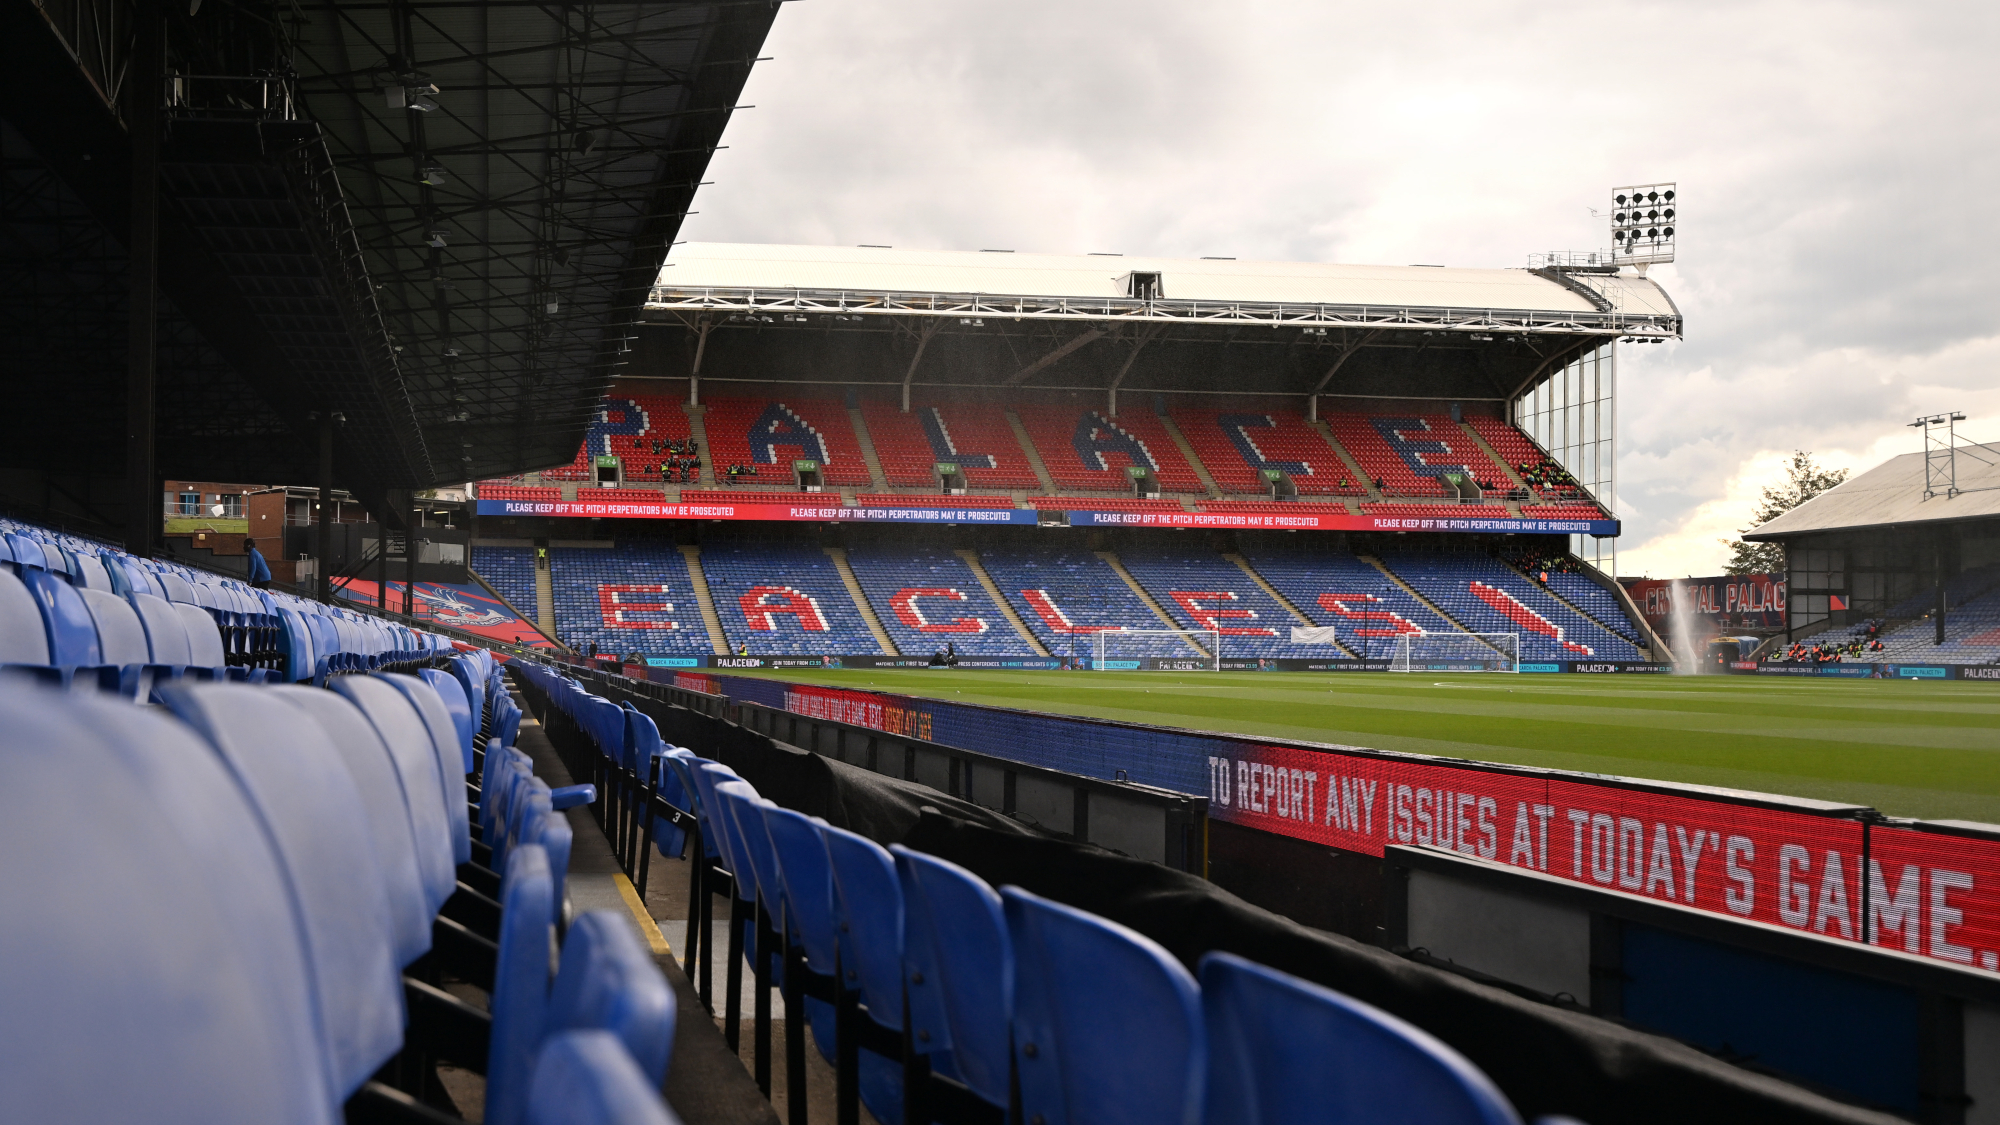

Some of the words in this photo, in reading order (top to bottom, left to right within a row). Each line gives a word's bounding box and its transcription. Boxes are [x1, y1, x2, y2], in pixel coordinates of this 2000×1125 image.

[506, 502, 533, 513] PLEASE
[535, 503, 553, 513] KEEP
[556, 504, 569, 513] OFF
[571, 504, 584, 513] THE
[586, 504, 605, 513] PITCH
[608, 504, 660, 515] PERPETRATORS
[662, 505, 677, 515] MAY
[679, 506, 688, 515] BE
[690, 506, 734, 516] PROSECUTED
[791, 508, 816, 517] PLEASE
[819, 508, 836, 518] KEEP
[839, 509, 851, 518] OFF
[853, 509, 865, 518] THE
[868, 509, 886, 519] PITCH
[889, 509, 939, 520] PERPETRATORS
[941, 510, 955, 520] MAY
[957, 510, 966, 520] BE
[968, 511, 1010, 521] PROSECUTED
[1095, 513, 1121, 523] PLEASE
[1123, 514, 1141, 523] KEEP
[1143, 514, 1156, 524] OFF
[1158, 514, 1171, 524] THE
[1173, 515, 1192, 524] PITCH
[1195, 515, 1245, 525] PERPETRATORS
[1248, 516, 1262, 526] MAY
[1265, 516, 1273, 526] BE
[1275, 516, 1318, 526] PROSECUTED
[1374, 518, 1400, 528] PLEASE
[1402, 519, 1419, 528] KEEP
[1422, 519, 1434, 528] OFF
[1436, 519, 1448, 529] THE
[1450, 520, 1469, 529] PITCH
[1471, 520, 1520, 530] PERPETRATORS
[1523, 521, 1536, 530] MAY
[1539, 521, 1547, 531] BE
[1549, 521, 1590, 531] PROSECUTED
[1646, 585, 1720, 614] CRYTAL
[1726, 581, 1786, 612] PALAC
[1208, 756, 1230, 806] TO
[1237, 760, 1317, 824] REPORT
[1325, 774, 1377, 836] ANY
[1387, 782, 1497, 860] ISSUES
[1511, 801, 1555, 871] AT
[1567, 808, 1755, 915] TODAY'S
[1778, 844, 1998, 972] GAME.
